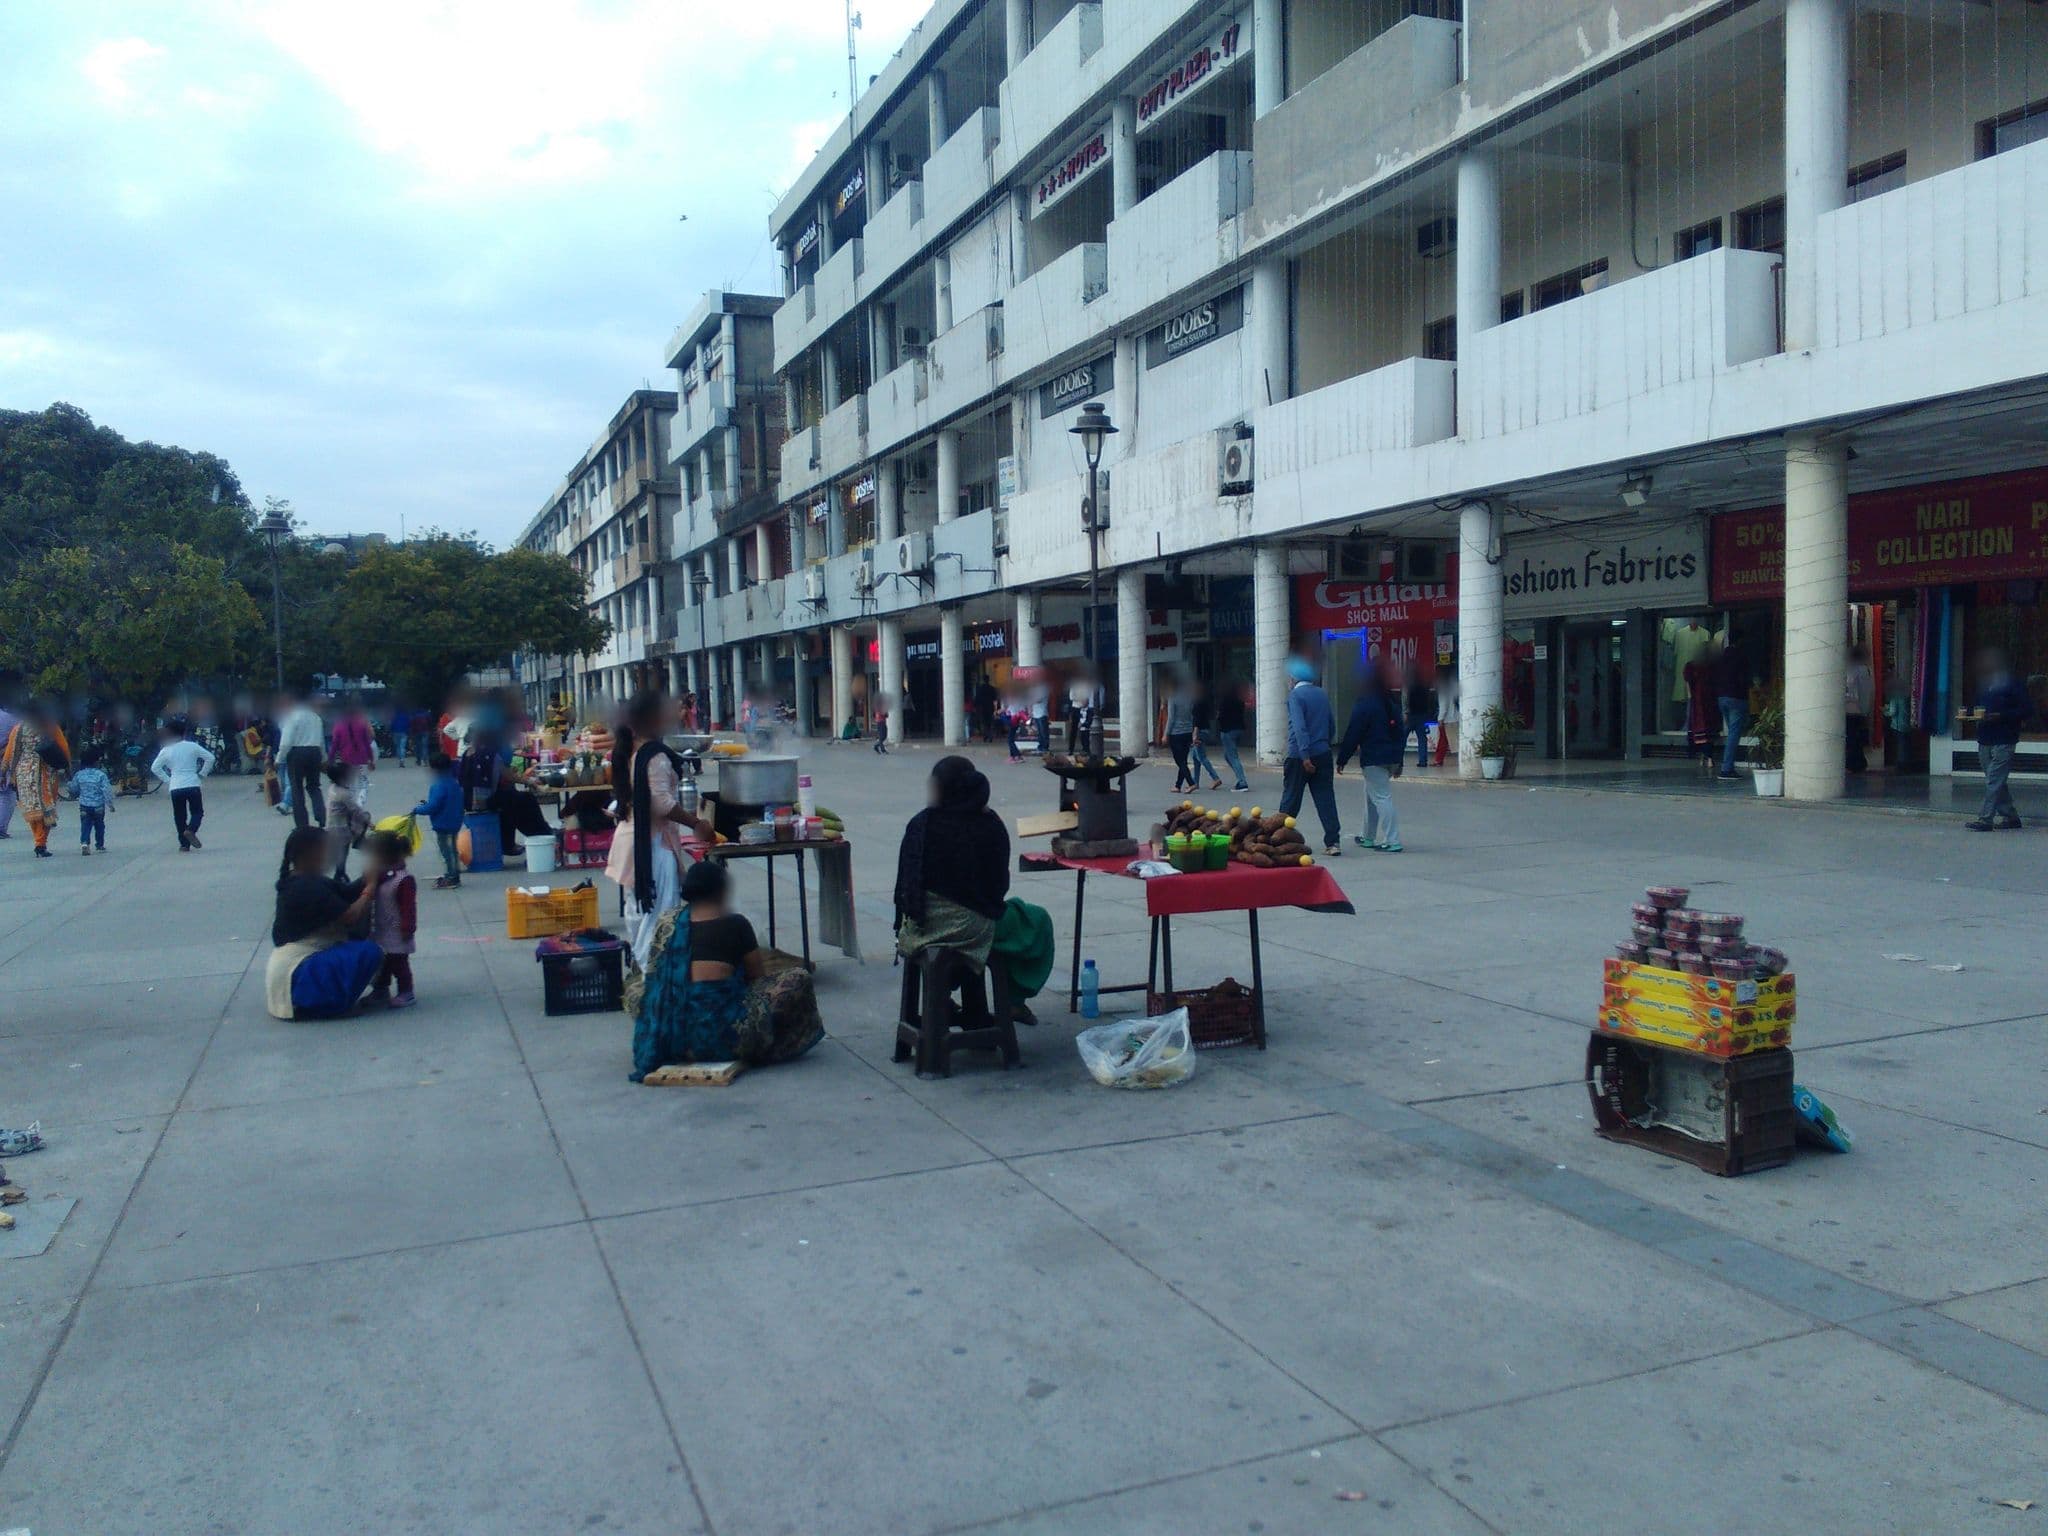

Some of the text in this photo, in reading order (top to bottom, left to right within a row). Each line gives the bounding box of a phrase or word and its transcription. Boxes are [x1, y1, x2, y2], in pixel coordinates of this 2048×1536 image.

[1138, 79, 1169, 121] CITY
[1169, 46, 1212, 99] PLAZA
[1066, 133, 1107, 182] HOTEL
[1164, 302, 1215, 344] LOOKS
[1053, 366, 1091, 399] LOOKS
[1916, 499, 1970, 531] NARI
[1736, 522, 1785, 548] 50%
[1876, 525, 2014, 567] COLLECTION
[1584, 545, 1697, 588] Fabrics
[1347, 604, 1409, 625] SHOE MALL
[979, 628, 1006, 654] poshak
